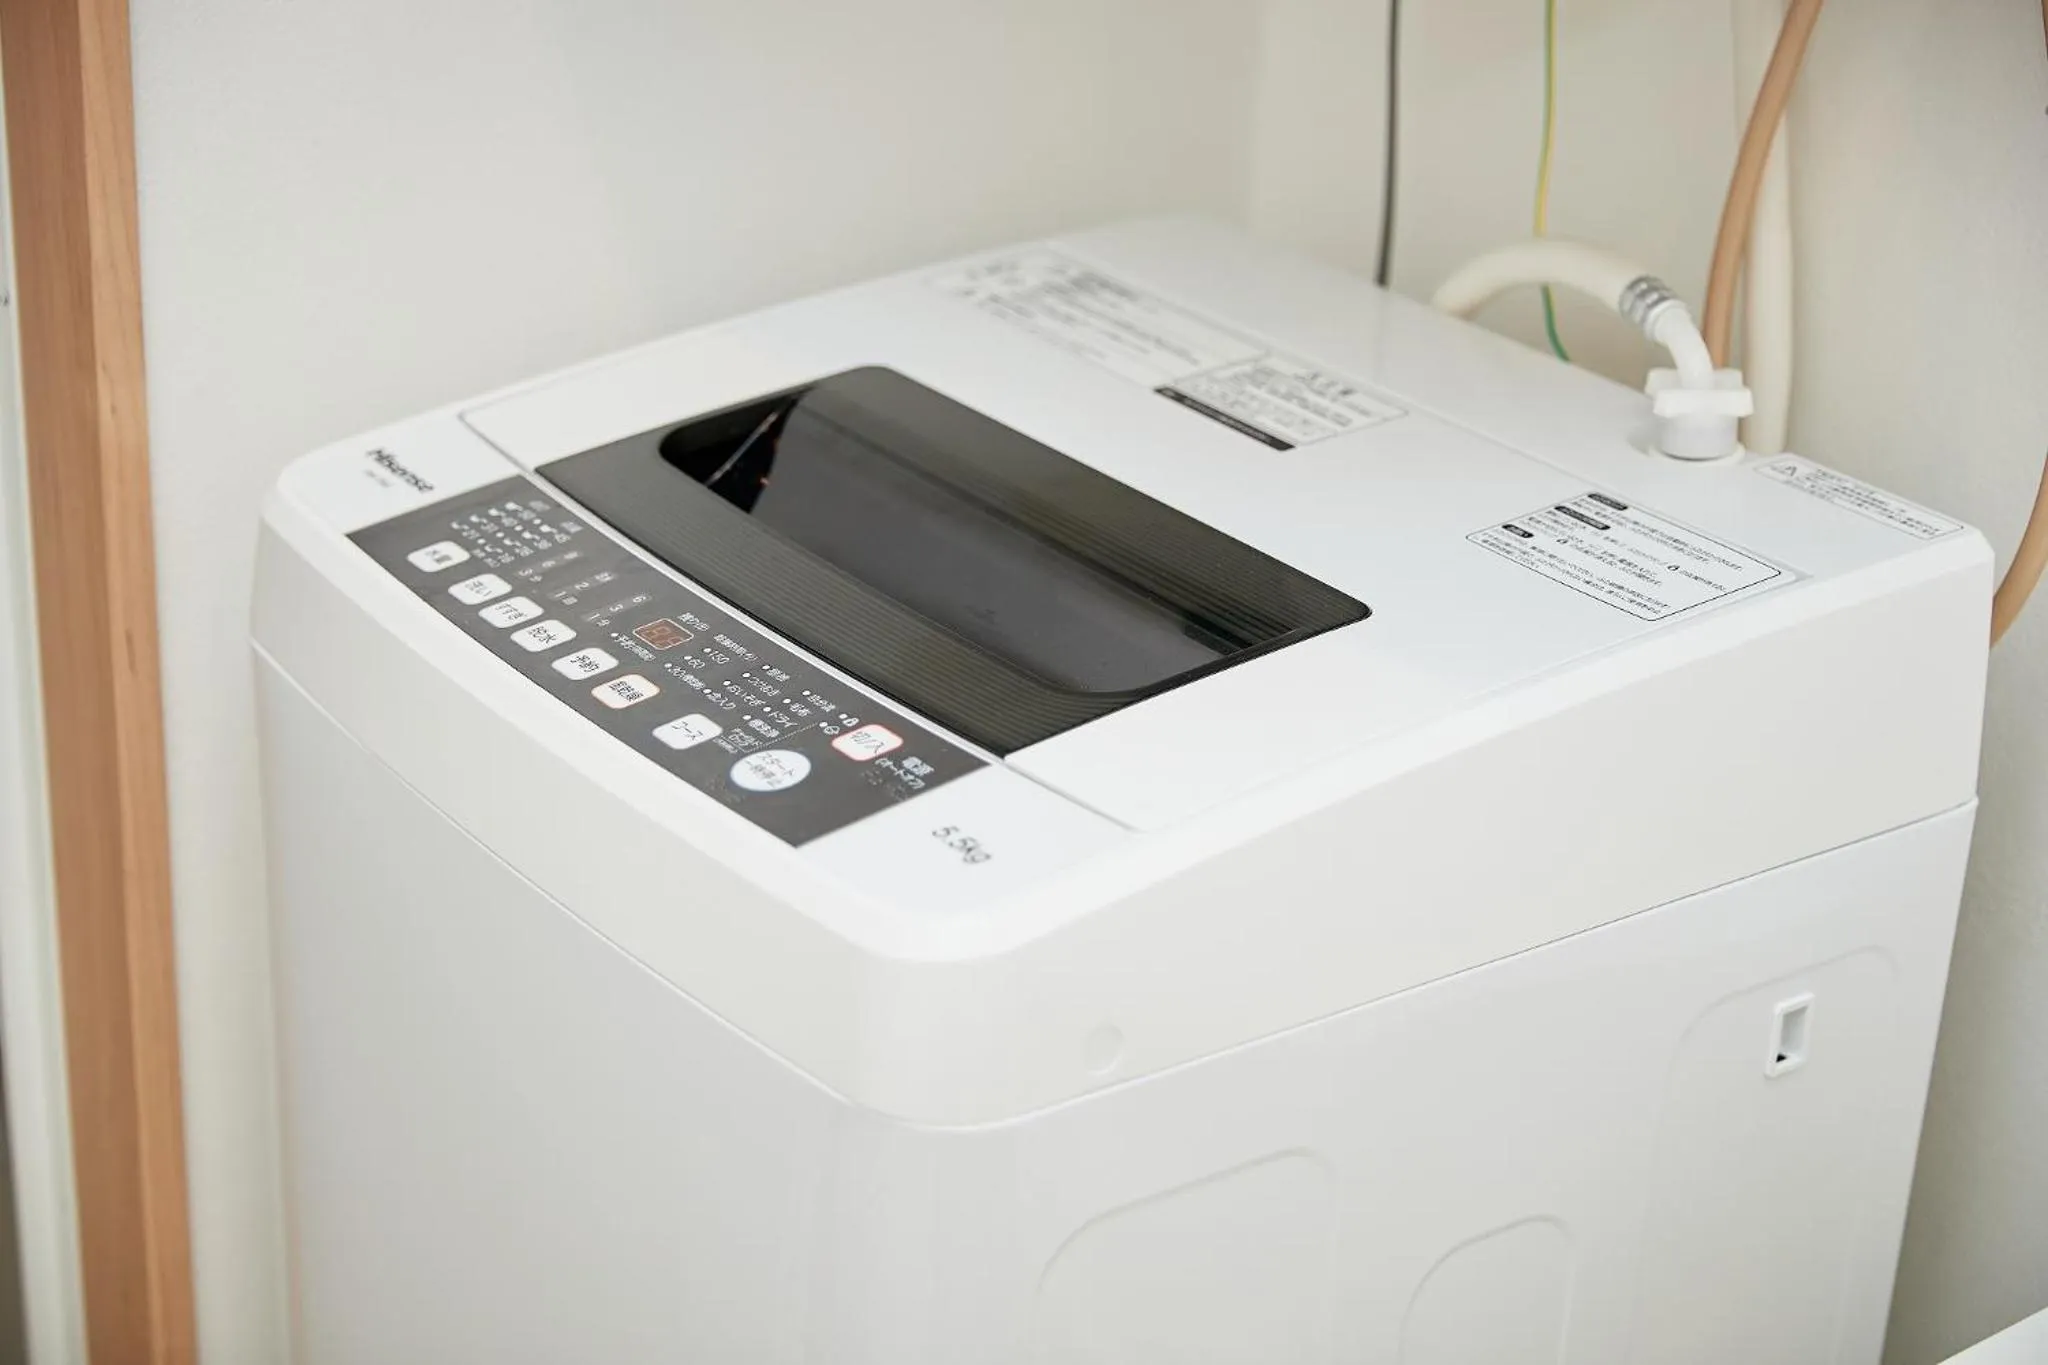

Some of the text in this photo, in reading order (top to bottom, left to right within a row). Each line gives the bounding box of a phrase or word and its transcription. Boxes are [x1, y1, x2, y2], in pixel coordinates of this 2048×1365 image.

[365, 448, 434, 492] Hisense
[609, 604, 623, 612] 3
[527, 626, 556, 644] 脱水
[570, 655, 600, 672] 予約
[688, 659, 705, 669] 60
[707, 650, 732, 664] 150
[726, 685, 765, 706] おいそぎ
[766, 711, 798, 728] ドライ
[672, 721, 703, 740] コース
[757, 752, 795, 776] スタート
[932, 825, 993, 866] 5.5kg
